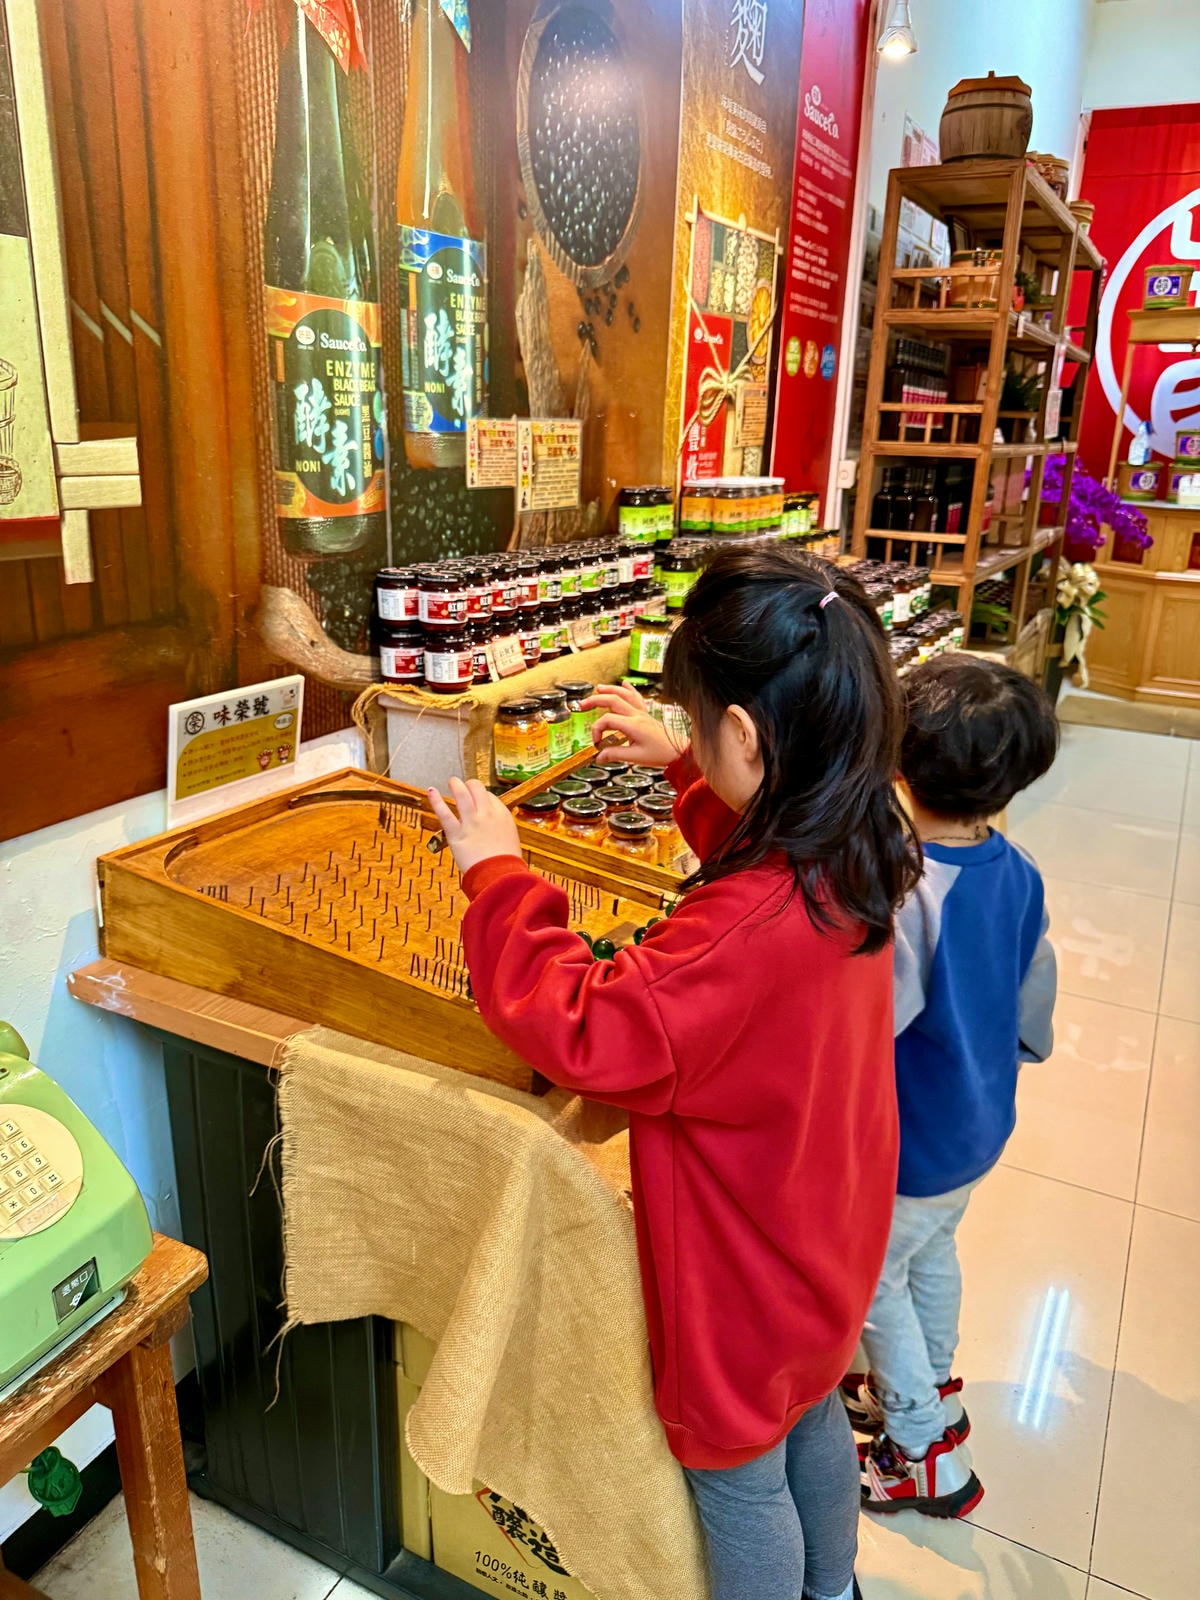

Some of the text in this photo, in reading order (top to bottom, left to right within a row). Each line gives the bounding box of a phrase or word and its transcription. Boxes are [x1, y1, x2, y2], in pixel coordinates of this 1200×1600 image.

[325, 359, 376, 378] ENZYME
[333, 378, 360, 392] BLACK
[424, 381, 445, 394] NONI
[333, 392, 360, 407] SAUCE
[295, 460, 321, 473] NONI
[213, 694, 270, 727] 味榮號
